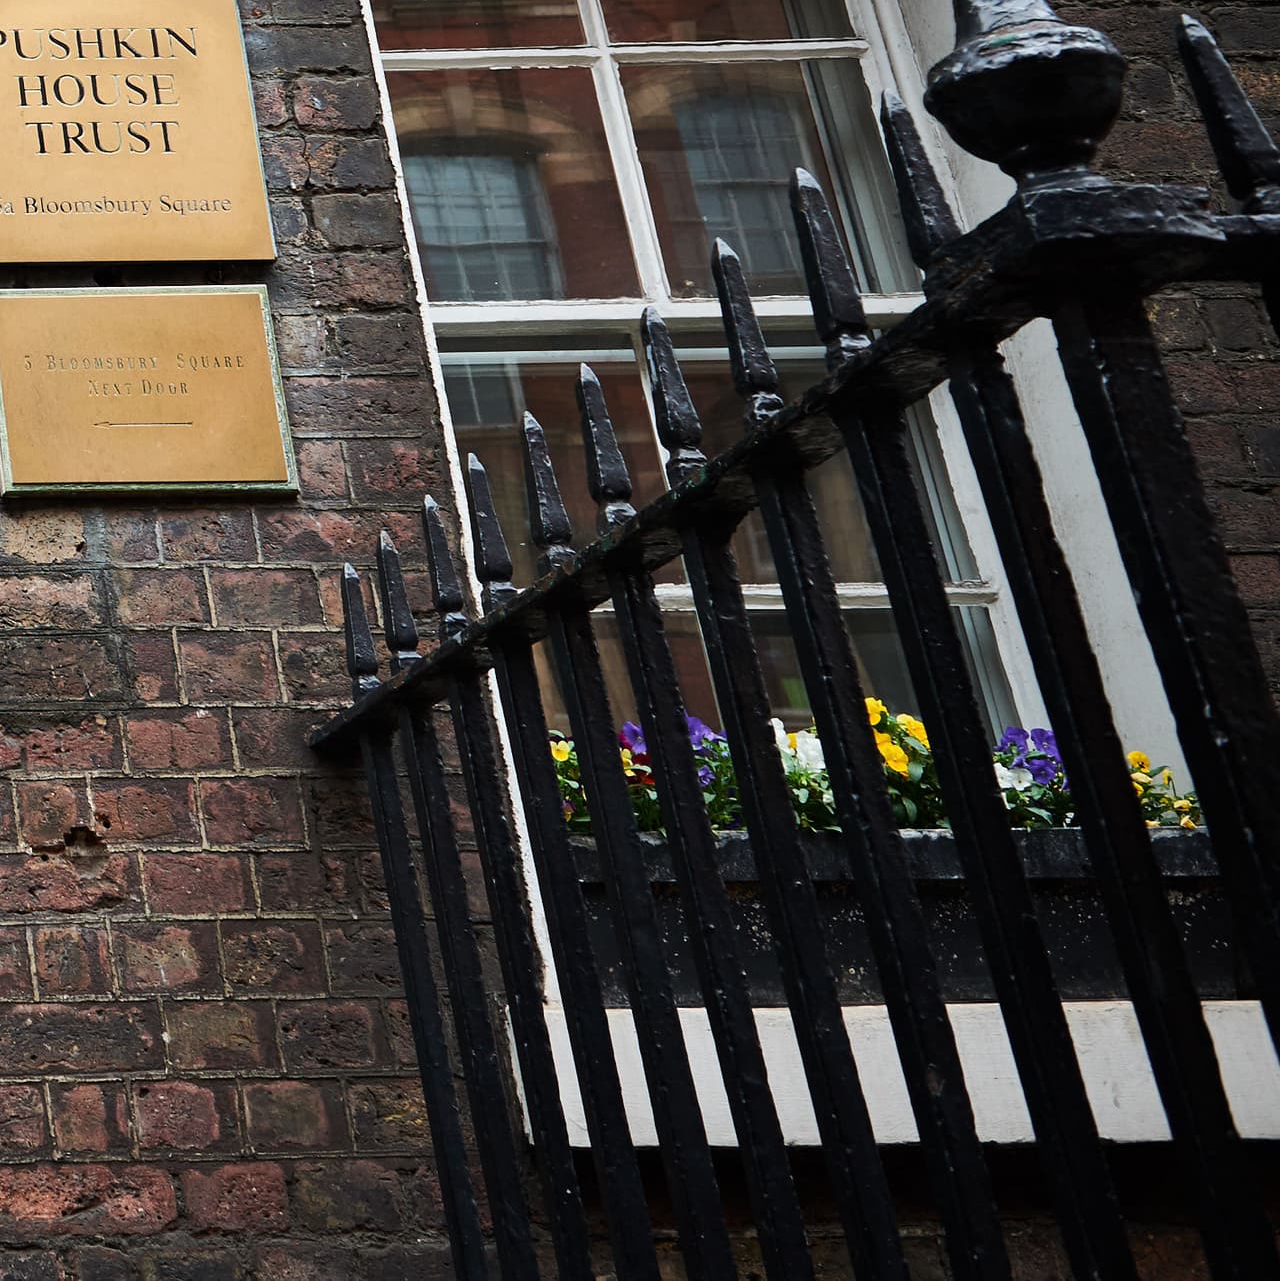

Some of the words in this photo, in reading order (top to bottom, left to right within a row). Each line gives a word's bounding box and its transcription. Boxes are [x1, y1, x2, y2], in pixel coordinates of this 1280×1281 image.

[14, 73, 180, 107] HOUSE
[25, 121, 180, 155] TRUST
[24, 196, 152, 215] Bloomsbury
[159, 195, 232, 215] Square
[24, 355, 32, 371] 5
[46, 354, 159, 371] BLOOMSBURY
[176, 353, 246, 370] SQUARE
[88, 380, 132, 397] NEXT
[141, 380, 189, 395] DOOR
